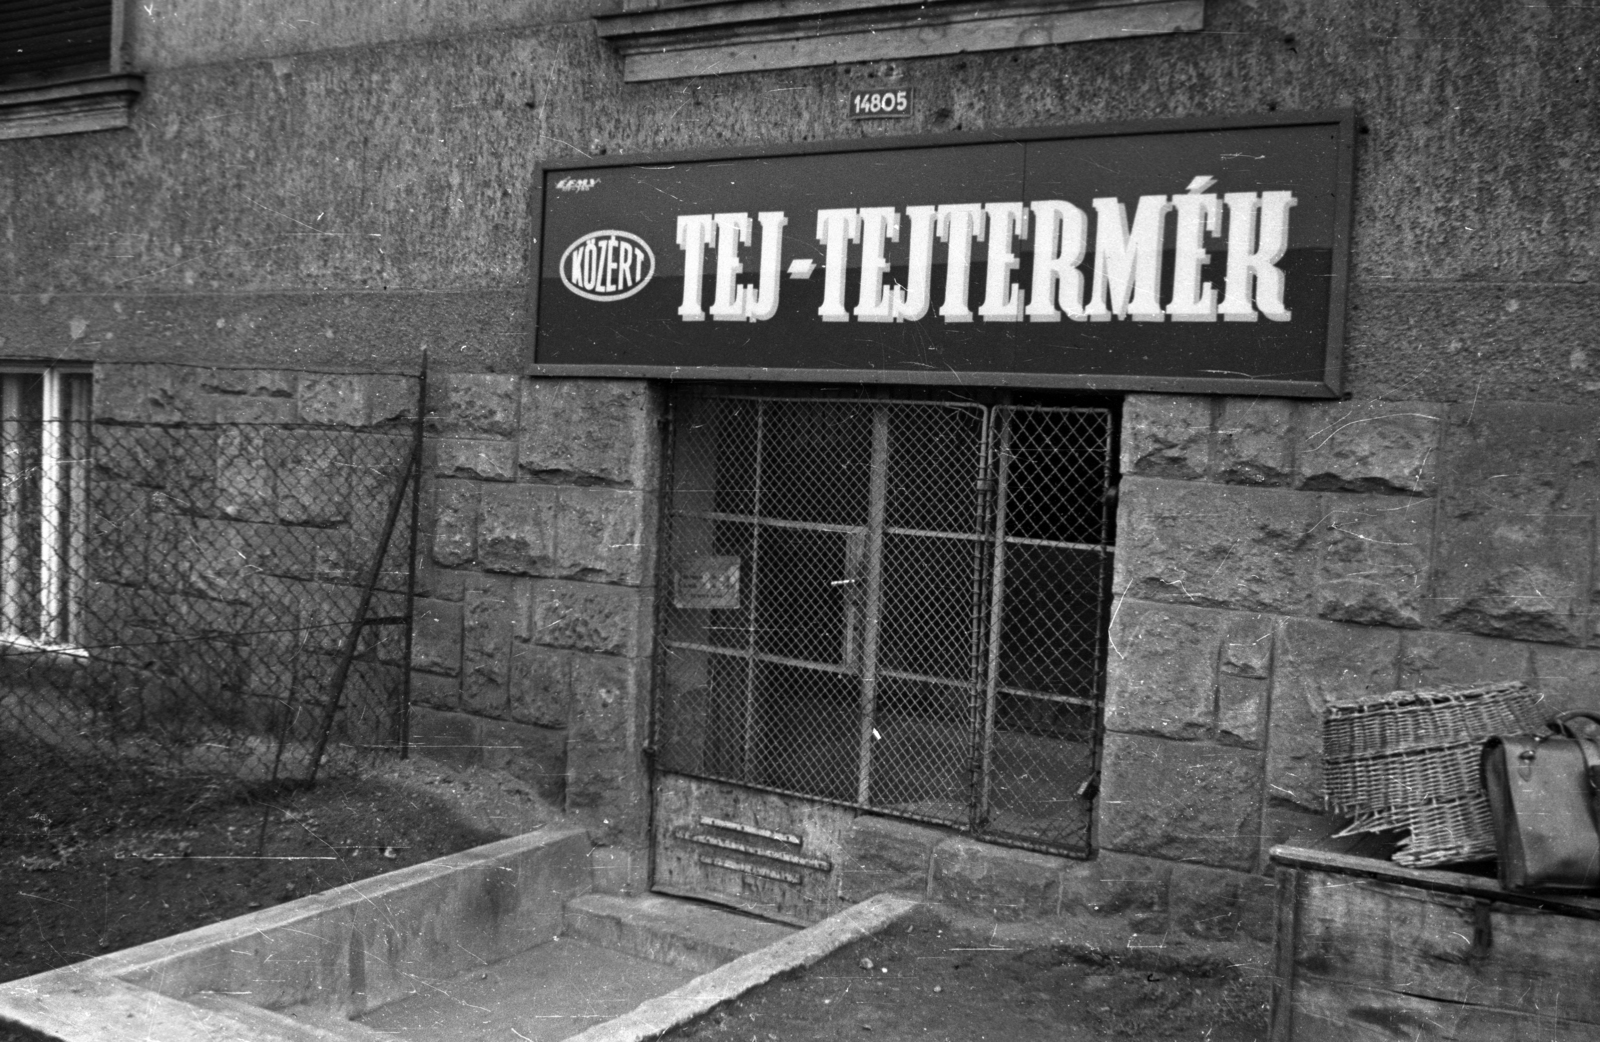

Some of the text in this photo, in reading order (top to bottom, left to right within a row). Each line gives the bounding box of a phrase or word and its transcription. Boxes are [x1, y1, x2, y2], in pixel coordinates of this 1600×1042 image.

[854, 91, 908, 113] 14805
[571, 235, 645, 293] KÖZÉRT
[676, 175, 1298, 323] TEJ-TEJTERMÉK
